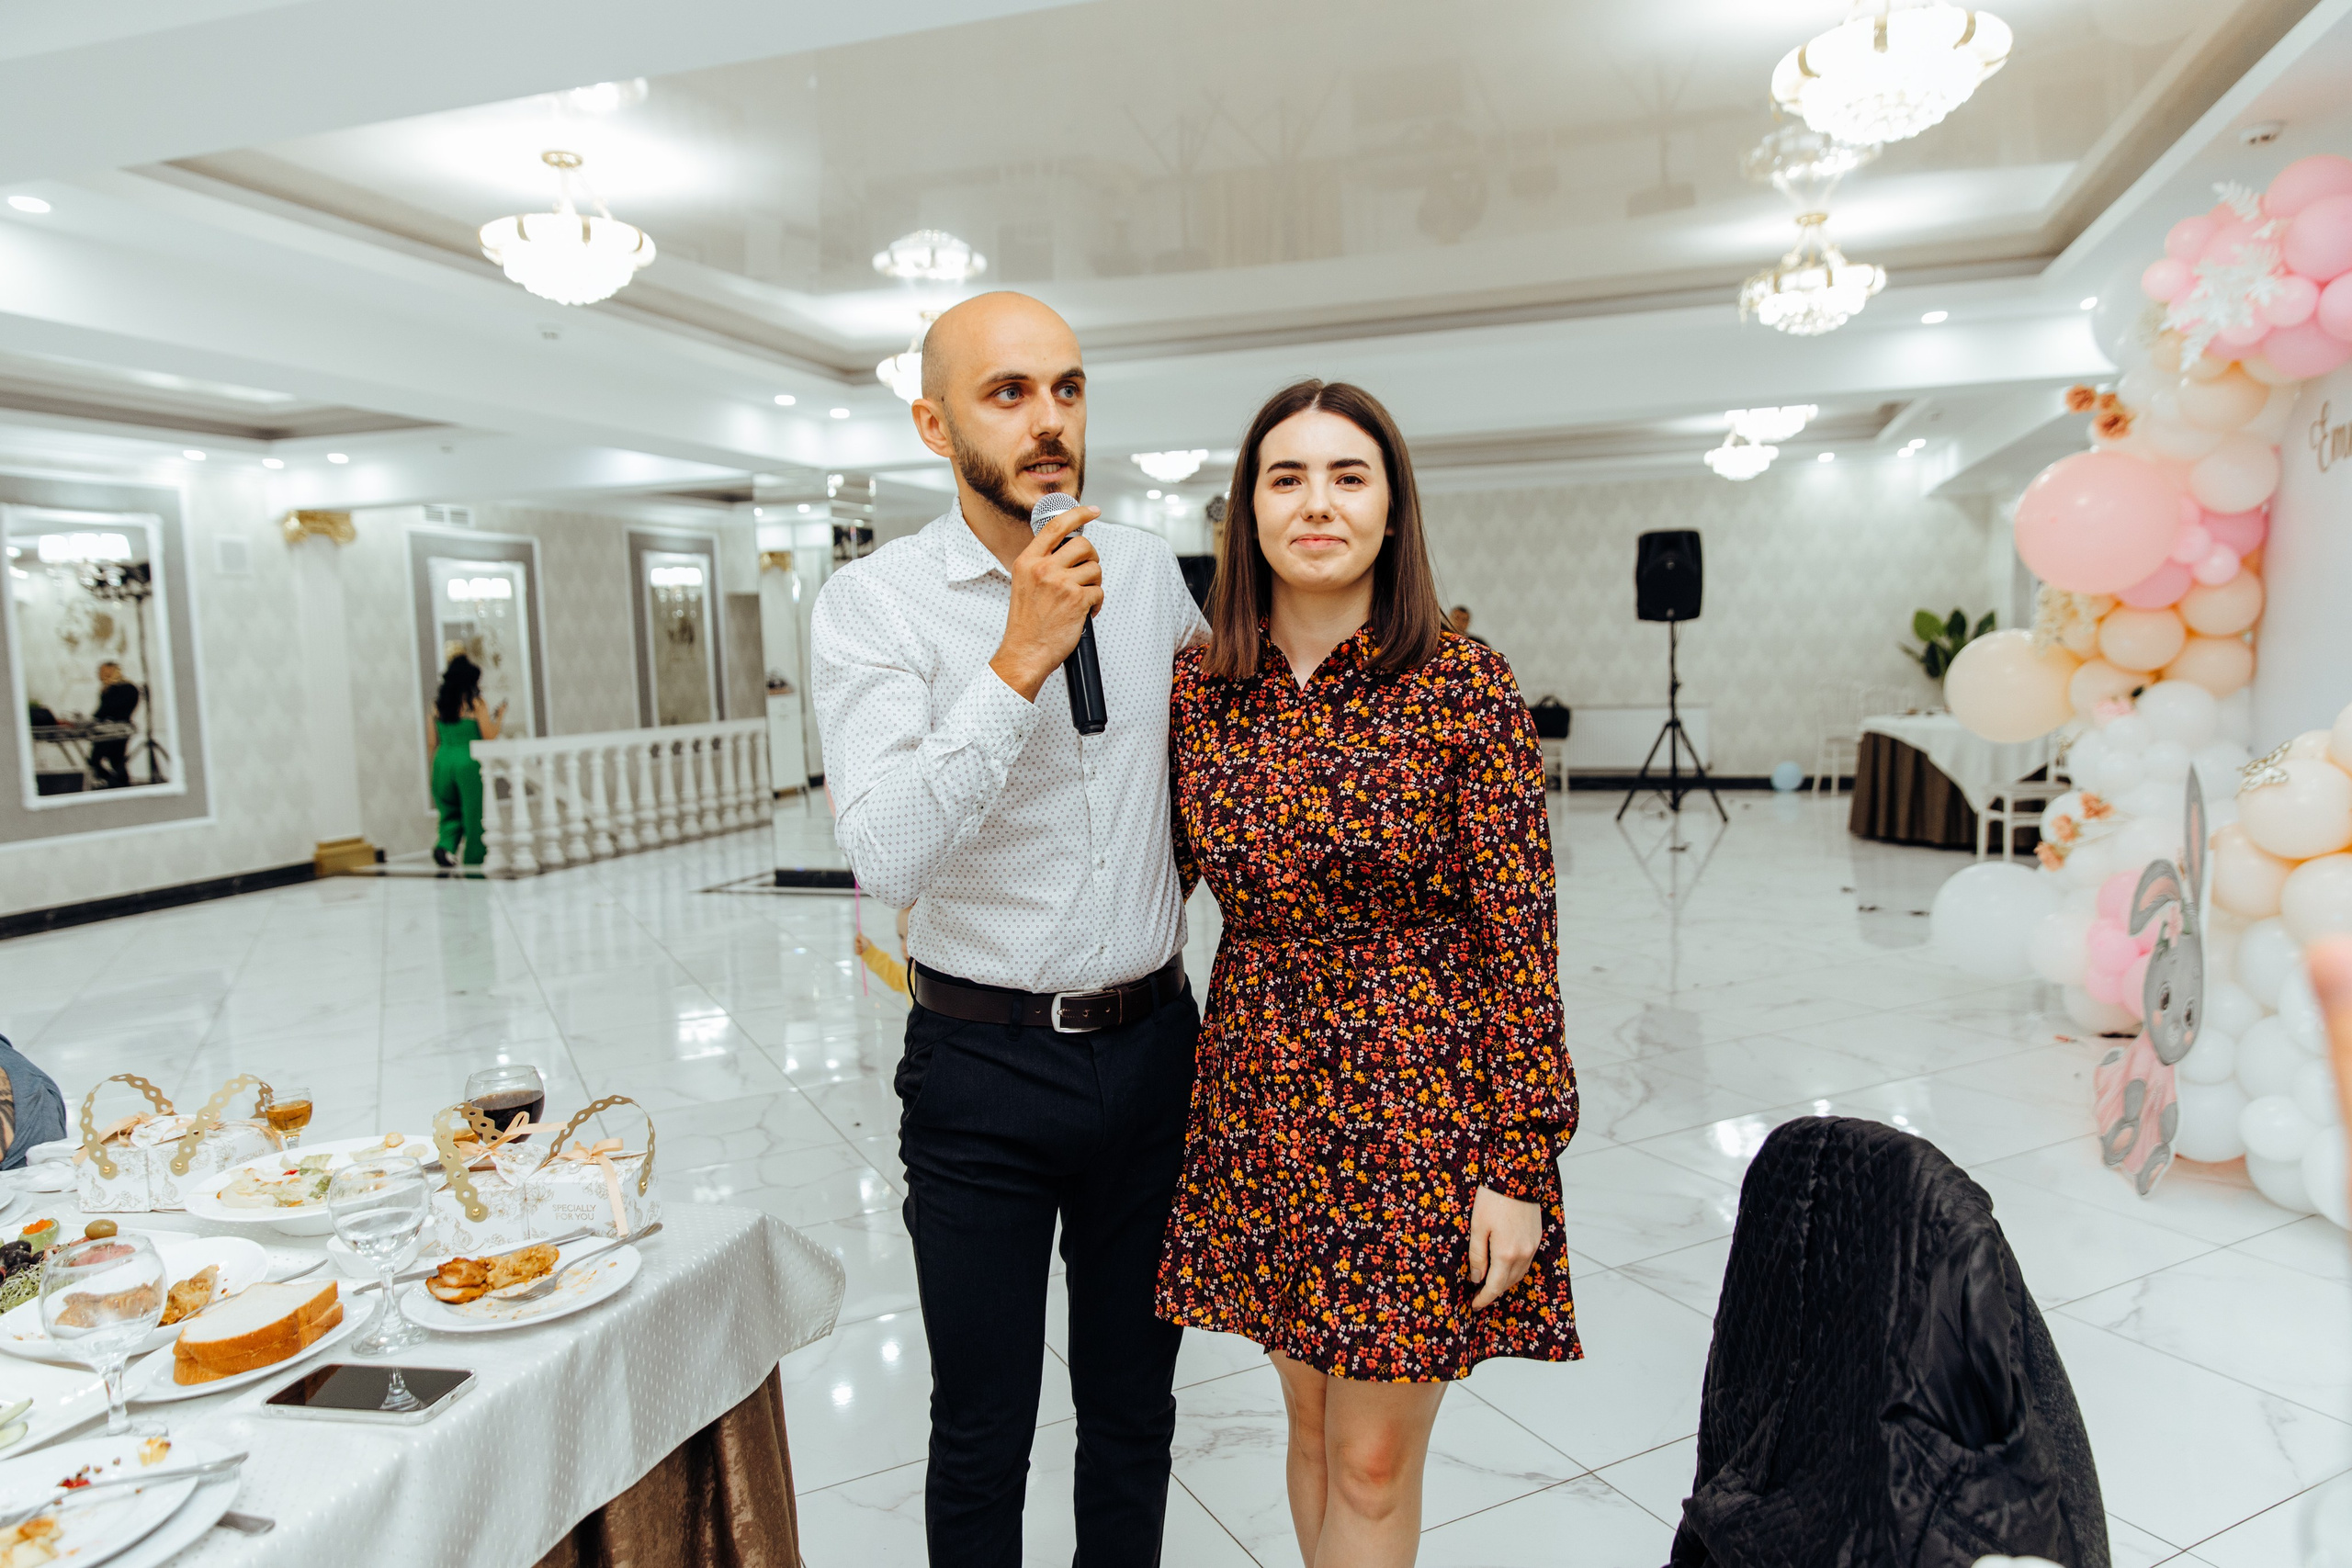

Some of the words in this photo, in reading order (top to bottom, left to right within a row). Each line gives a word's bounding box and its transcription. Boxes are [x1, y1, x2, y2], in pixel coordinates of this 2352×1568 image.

[552, 1203, 596, 1213] SPECIALLY
[555, 1213, 573, 1221] FOR
[575, 1213, 594, 1221] YOU
